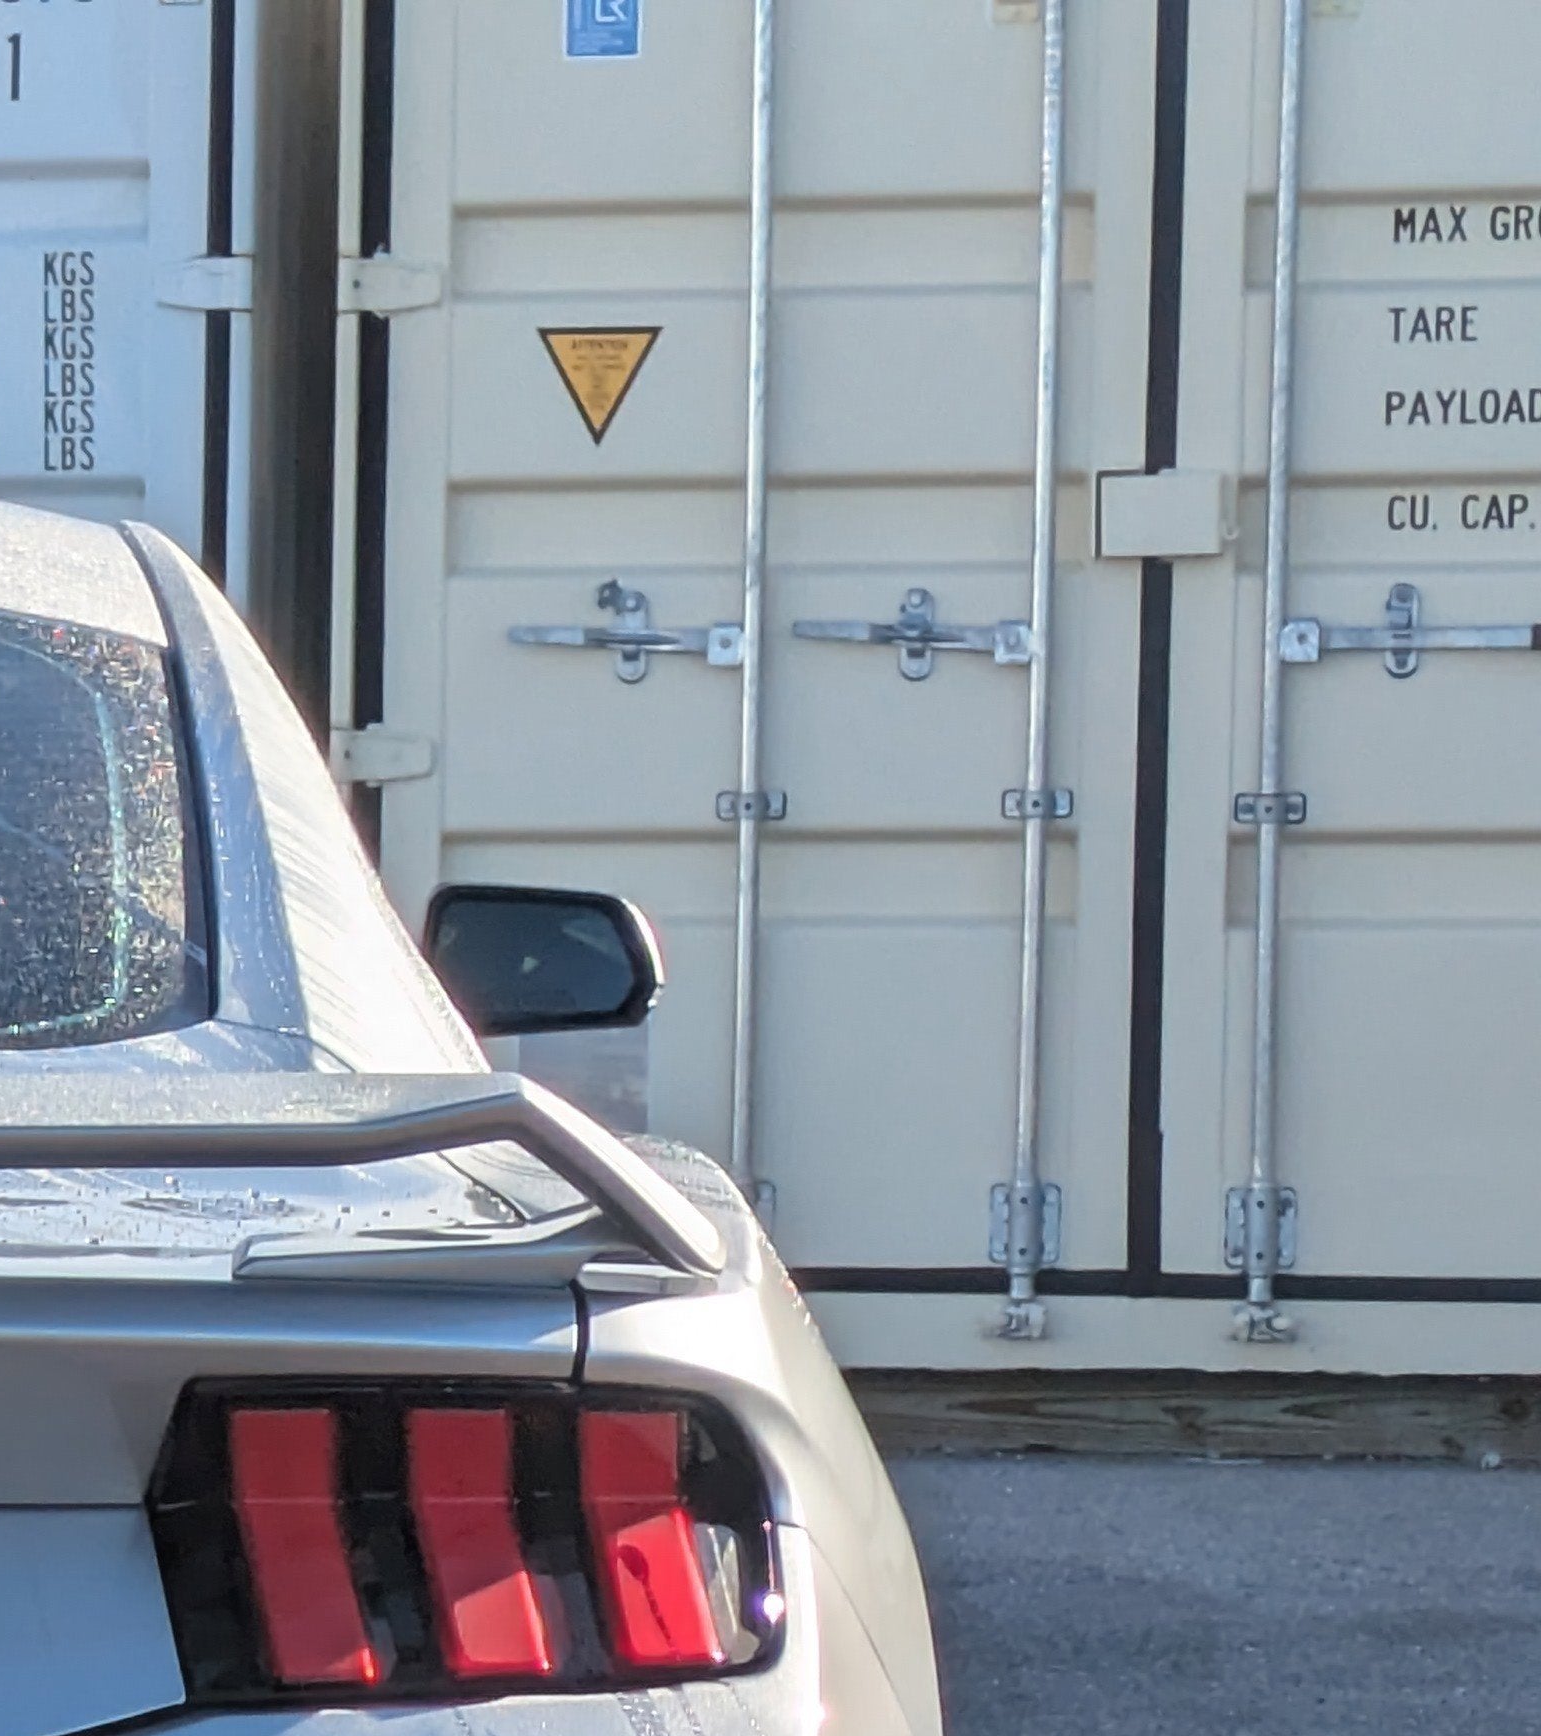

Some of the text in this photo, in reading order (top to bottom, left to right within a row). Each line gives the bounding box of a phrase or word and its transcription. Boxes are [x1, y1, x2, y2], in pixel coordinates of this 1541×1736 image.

[1393, 204, 1541, 243] MAX GR
[43, 250, 96, 288] KGS
[43, 287, 96, 325] LBS
[1388, 305, 1479, 343] TARE
[43, 324, 96, 361] KGS
[43, 361, 96, 399] LBS
[43, 398, 96, 435] KGS
[1385, 387, 1541, 426] PAYLOAD
[43, 434, 96, 472] LBS
[1387, 492, 1536, 531] CU. CAP.
